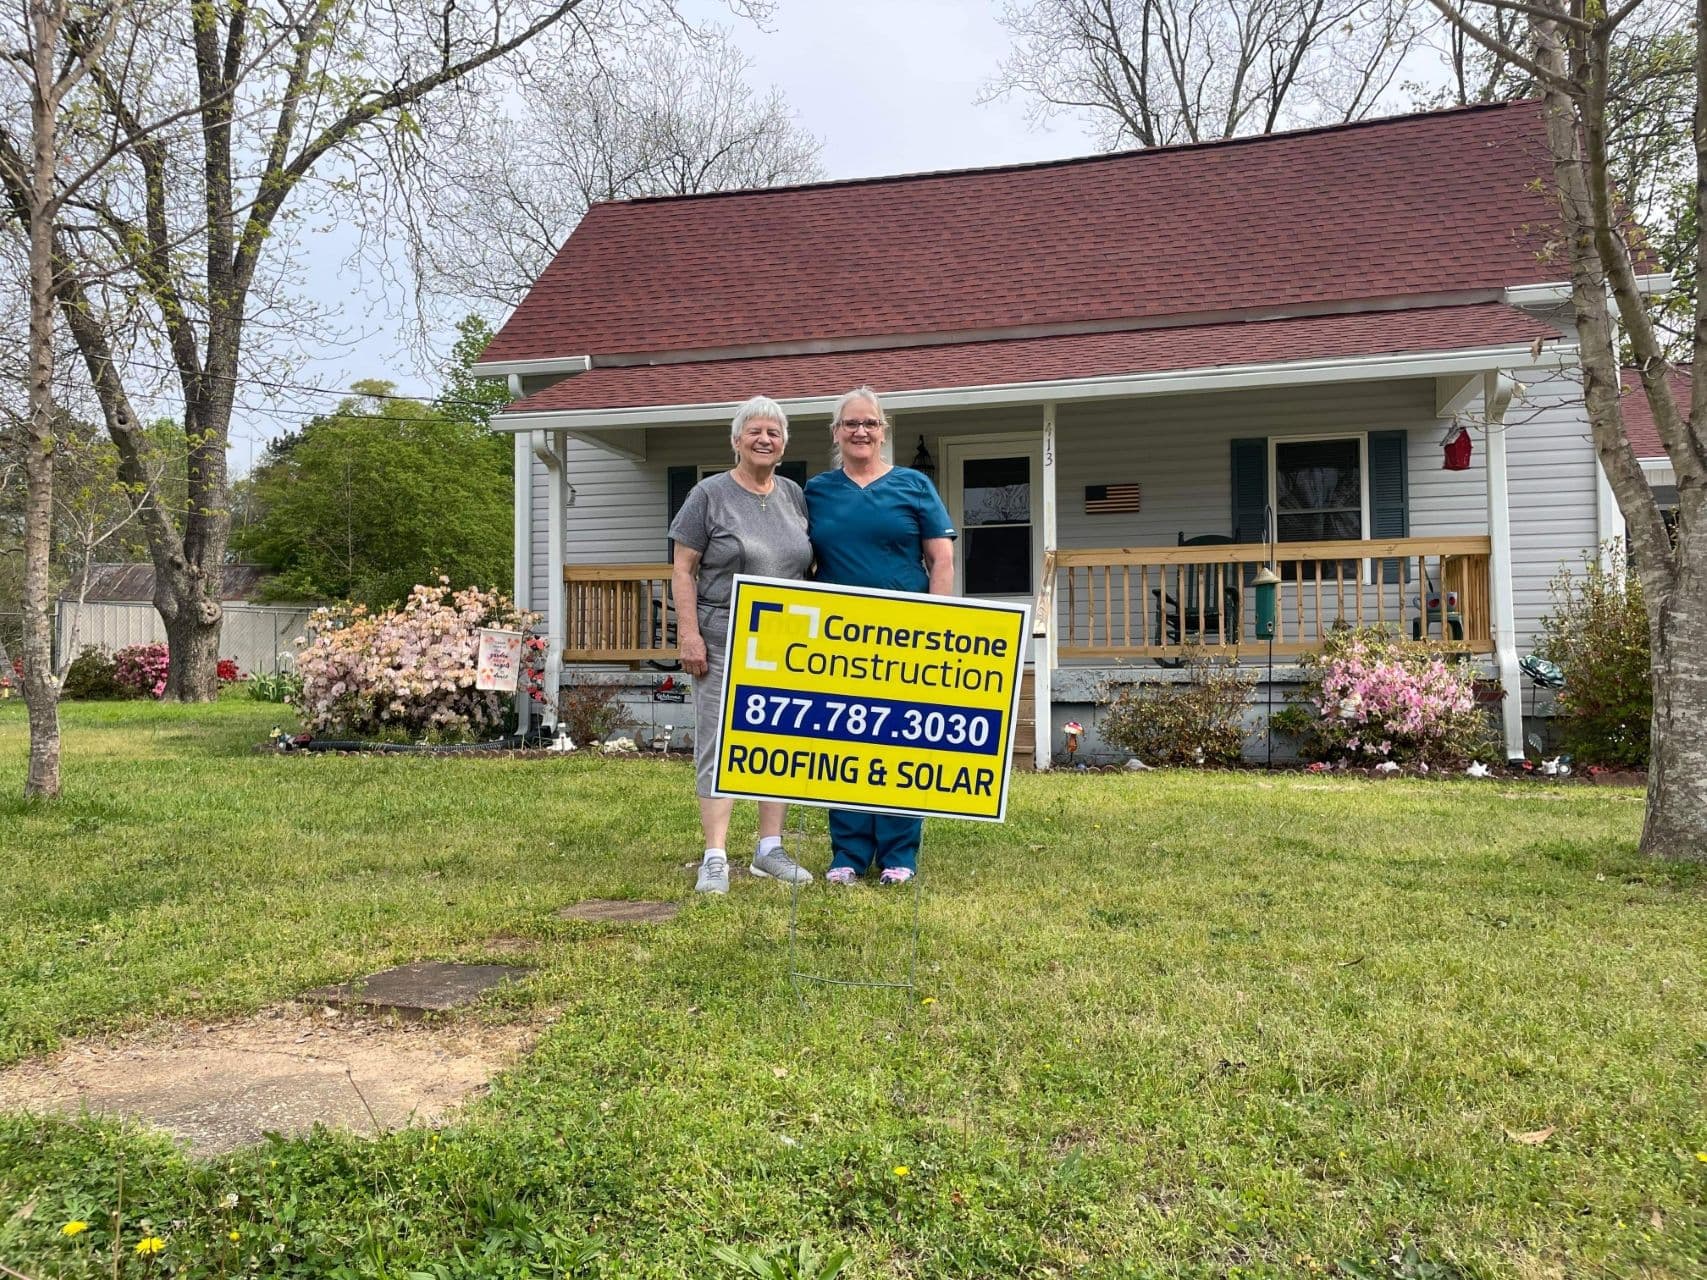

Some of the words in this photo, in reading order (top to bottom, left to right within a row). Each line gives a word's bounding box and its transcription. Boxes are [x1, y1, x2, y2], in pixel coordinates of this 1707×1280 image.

[824, 615, 1008, 657] Cornerstone
[785, 643, 1003, 693] Construction
[745, 694, 990, 747] 877.787.3030
[728, 744, 859, 784] ROOFING
[867, 758, 887, 787] &
[896, 761, 994, 797] SOLAR
